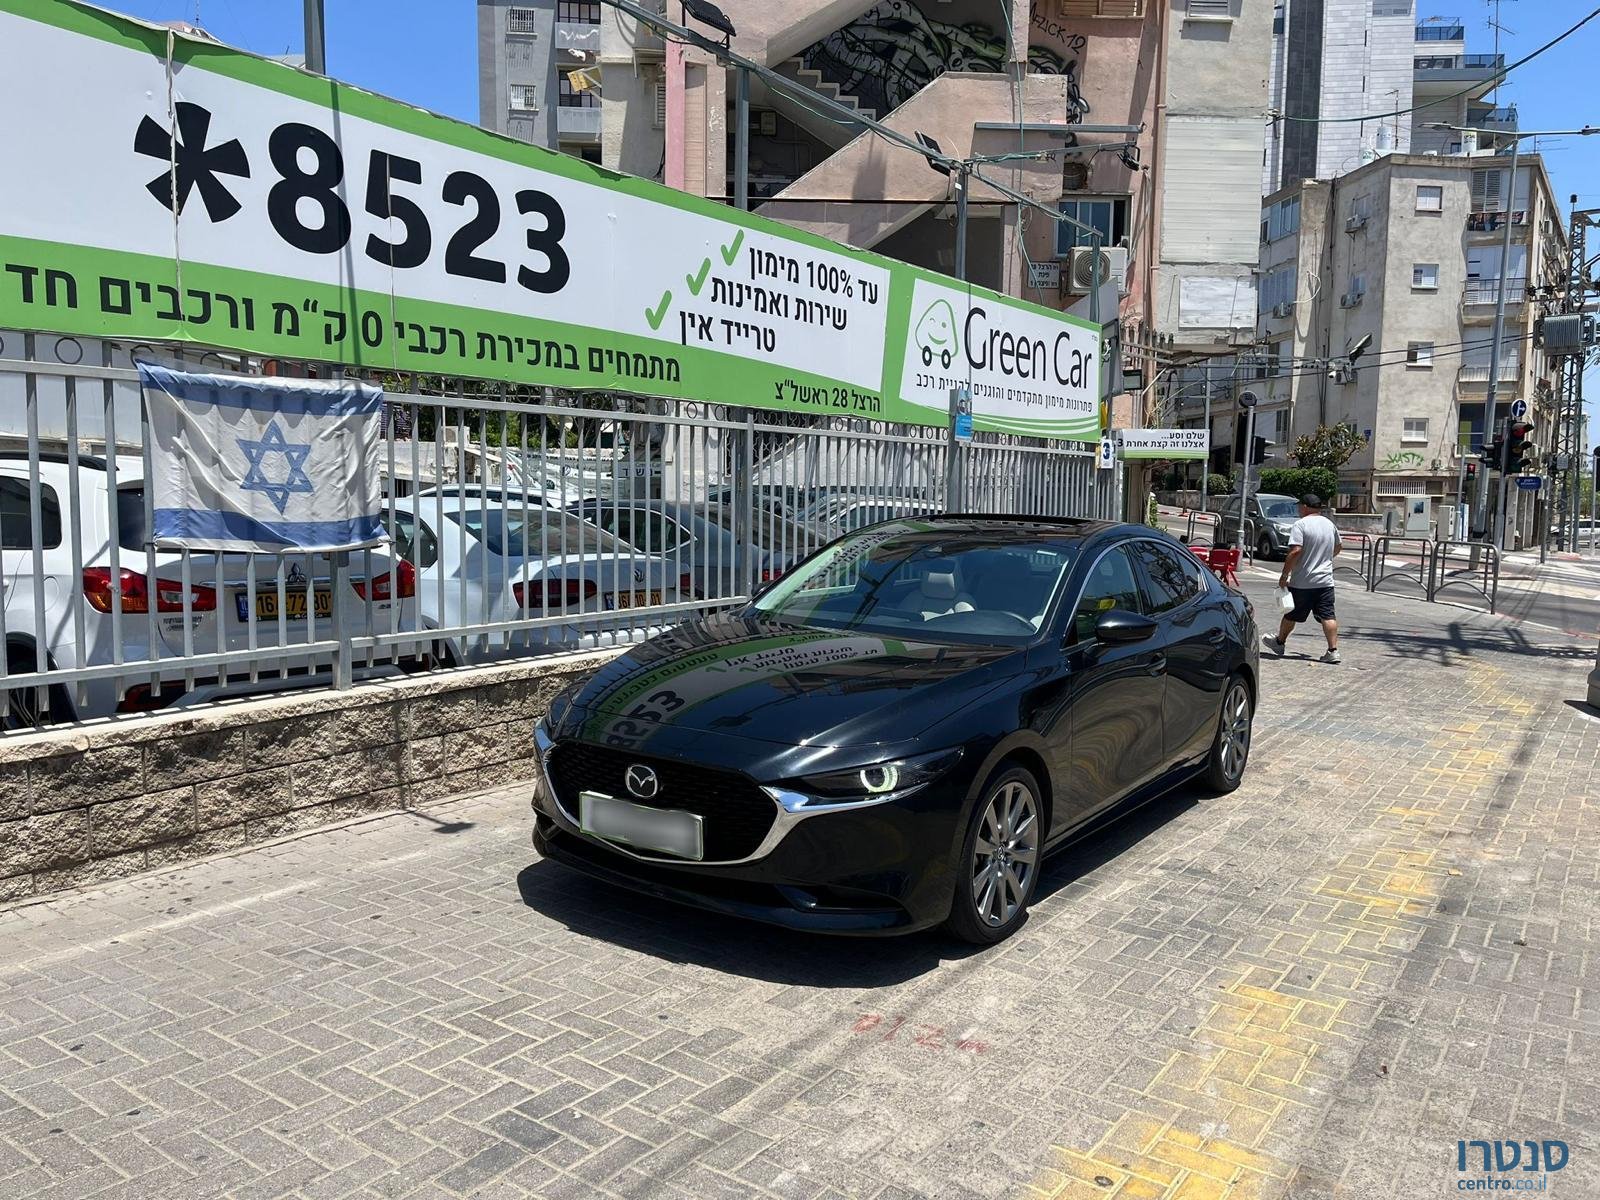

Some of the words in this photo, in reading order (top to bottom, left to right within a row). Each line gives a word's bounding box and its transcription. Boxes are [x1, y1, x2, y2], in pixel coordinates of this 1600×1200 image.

[749, 247, 799, 284] מימון
[806, 260, 853, 298] 100%
[99, 276, 255, 331] ורכבים
[711, 276, 788, 318] ואמינות
[857, 278, 878, 304] עד
[361, 310, 383, 348] 0
[679, 310, 713, 345] אין
[794, 297, 847, 331] שירות
[394, 321, 466, 358] רכבי
[720, 318, 776, 352] טרייד
[964, 307, 1047, 381] Green
[1053, 331, 1092, 389] Car
[476, 331, 580, 370] במכירת
[588, 347, 680, 382] מתמחים
[916, 373, 935, 388] רכב
[973, 383, 1004, 399] והוגנים
[832, 387, 848, 408] 28
[851, 389, 881, 413] הרצל
[1007, 389, 1043, 406] מתקדמים
[1045, 394, 1064, 409] מימון
[1126, 440, 1149, 448] אחרת
[1150, 440, 1168, 449] קצת
[1170, 440, 1180, 448] זה
[1182, 440, 1205, 448] אצלנו
[1186, 431, 1205, 439] שלם
